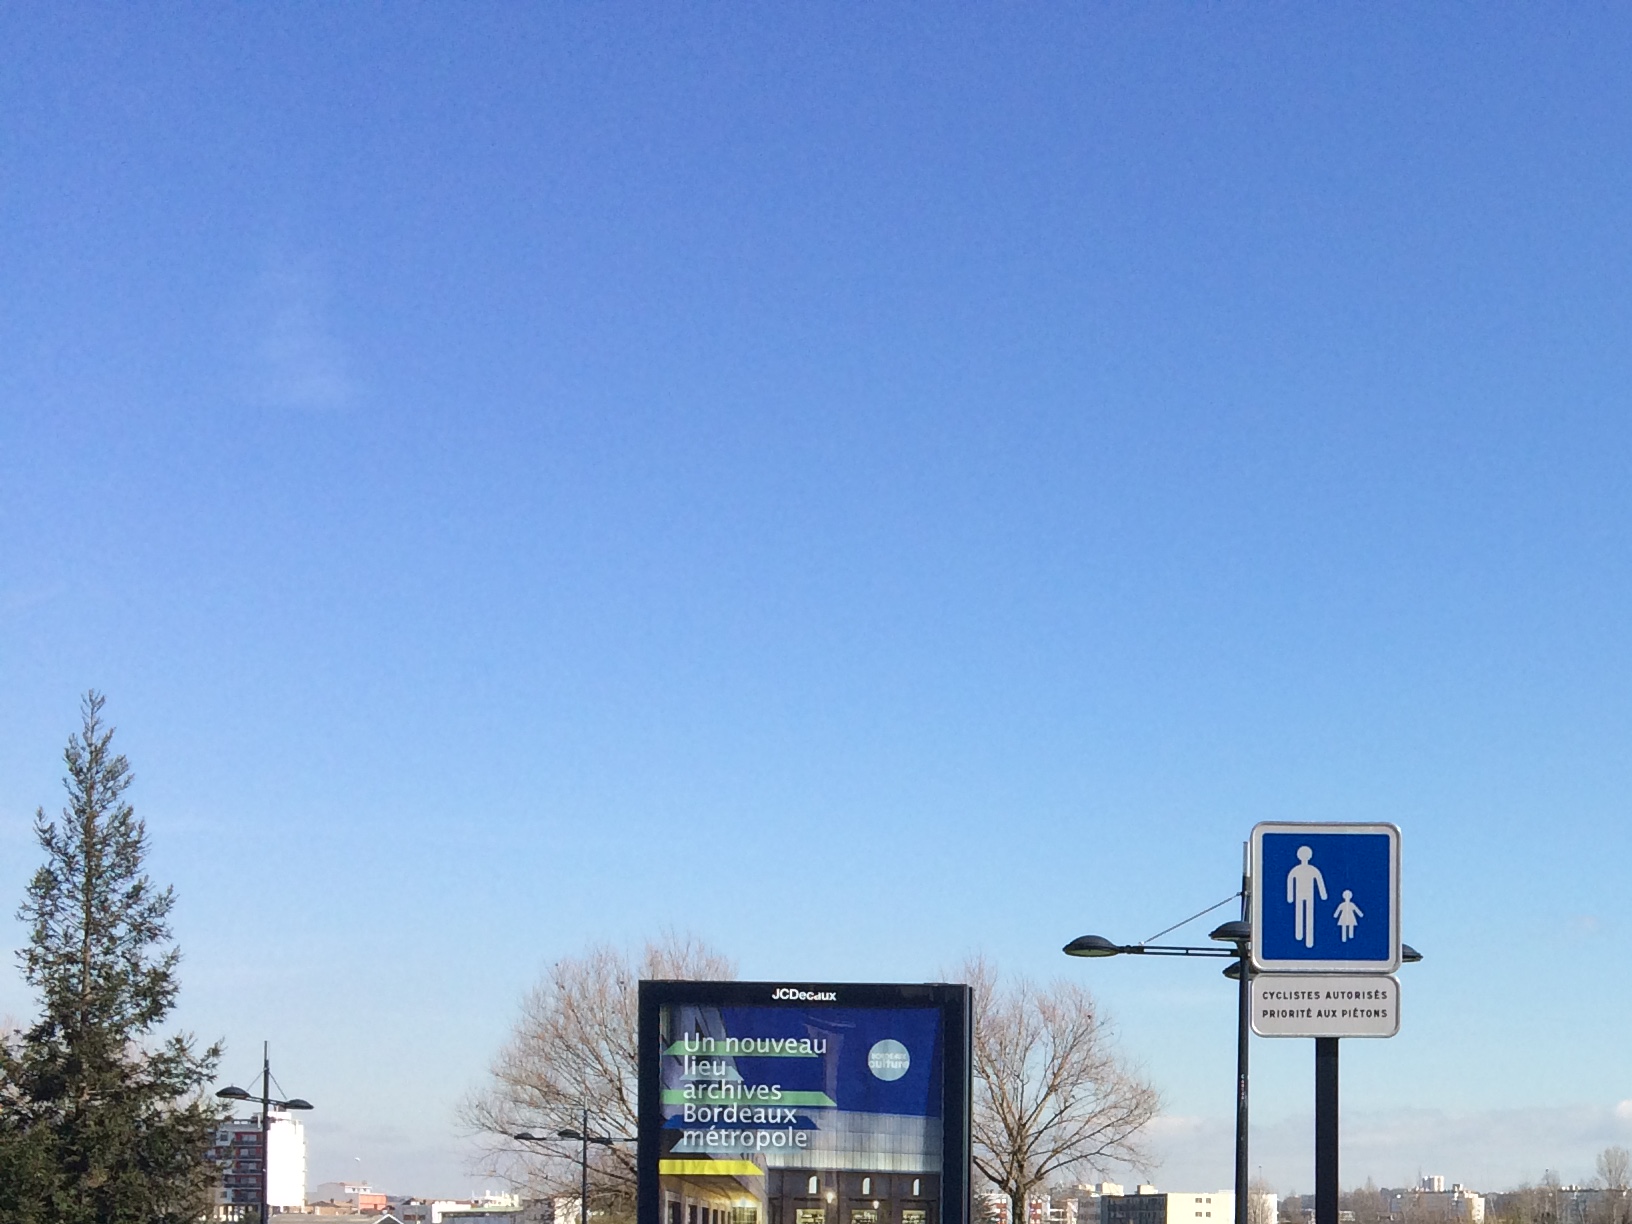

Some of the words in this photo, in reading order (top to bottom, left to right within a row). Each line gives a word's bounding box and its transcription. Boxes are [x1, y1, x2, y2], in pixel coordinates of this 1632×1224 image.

[771, 988, 837, 1001] JCDecaux
[1262, 991, 1321, 1000] CYCLISTES
[1325, 989, 1388, 1000] AUTORISÉS
[1262, 1008, 1312, 1018] PRIORITÉ
[1316, 1009, 1337, 1018] AUX
[1341, 1007, 1388, 1018] PIÉTONS
[683, 1032, 716, 1053] Un
[725, 1037, 828, 1055] nouveau
[683, 1055, 726, 1076] lieu
[683, 1080, 782, 1101] archives
[683, 1103, 798, 1124] Bordeaux
[683, 1126, 808, 1150] métropole
